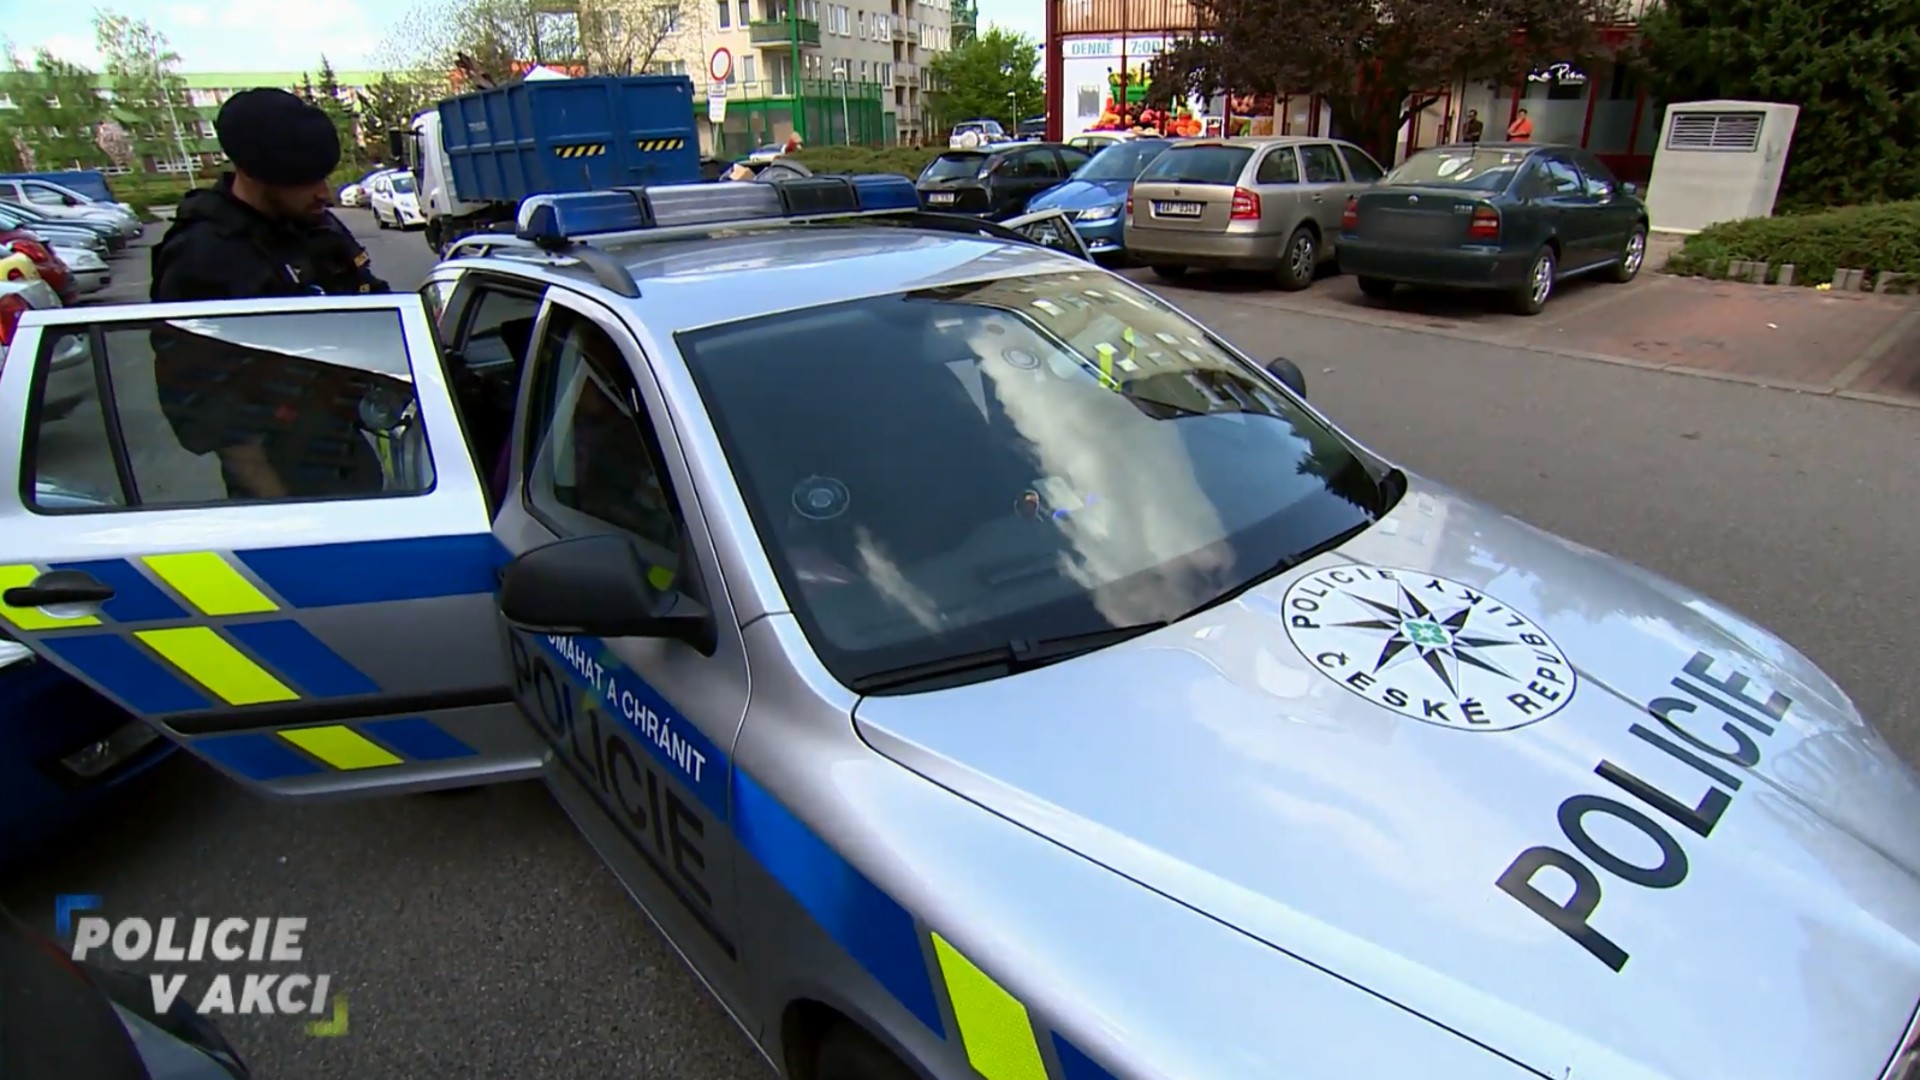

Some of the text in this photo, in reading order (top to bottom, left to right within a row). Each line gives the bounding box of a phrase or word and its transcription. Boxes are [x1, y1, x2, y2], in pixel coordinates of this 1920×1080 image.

[1291, 568, 1399, 630] POLICIE
[1316, 579, 1566, 725] ČESKÉ REPUBLIKY
[507, 625, 714, 908] POLICIE
[606, 676, 618, 708] A
[621, 690, 706, 783] CHRÁNIT
[1494, 650, 1793, 973] POLICIE
